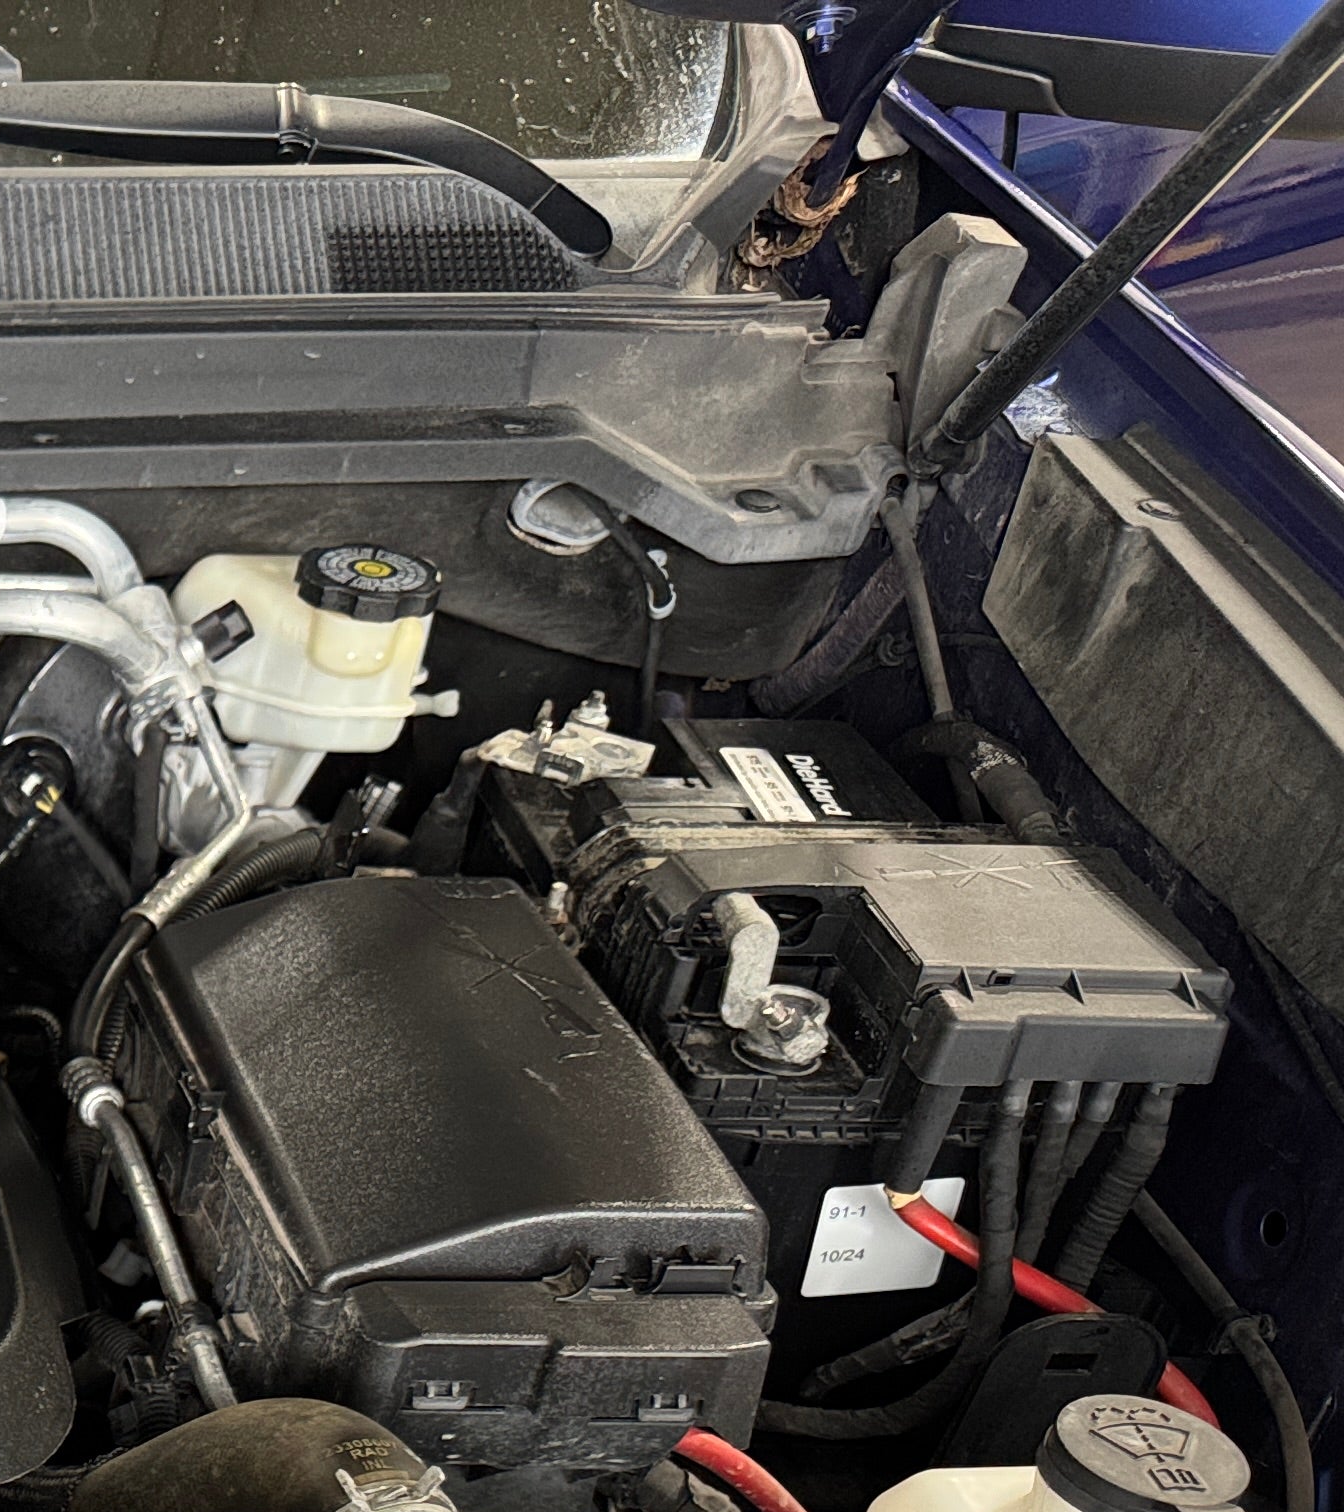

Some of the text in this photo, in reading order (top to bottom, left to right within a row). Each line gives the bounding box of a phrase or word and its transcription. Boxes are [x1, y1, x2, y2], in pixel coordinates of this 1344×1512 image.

[784, 754, 853, 817] DieHard
[828, 1205, 866, 1220] 91-1
[819, 1248, 865, 1264] 10/24
[350, 1447, 390, 1460] RAD
